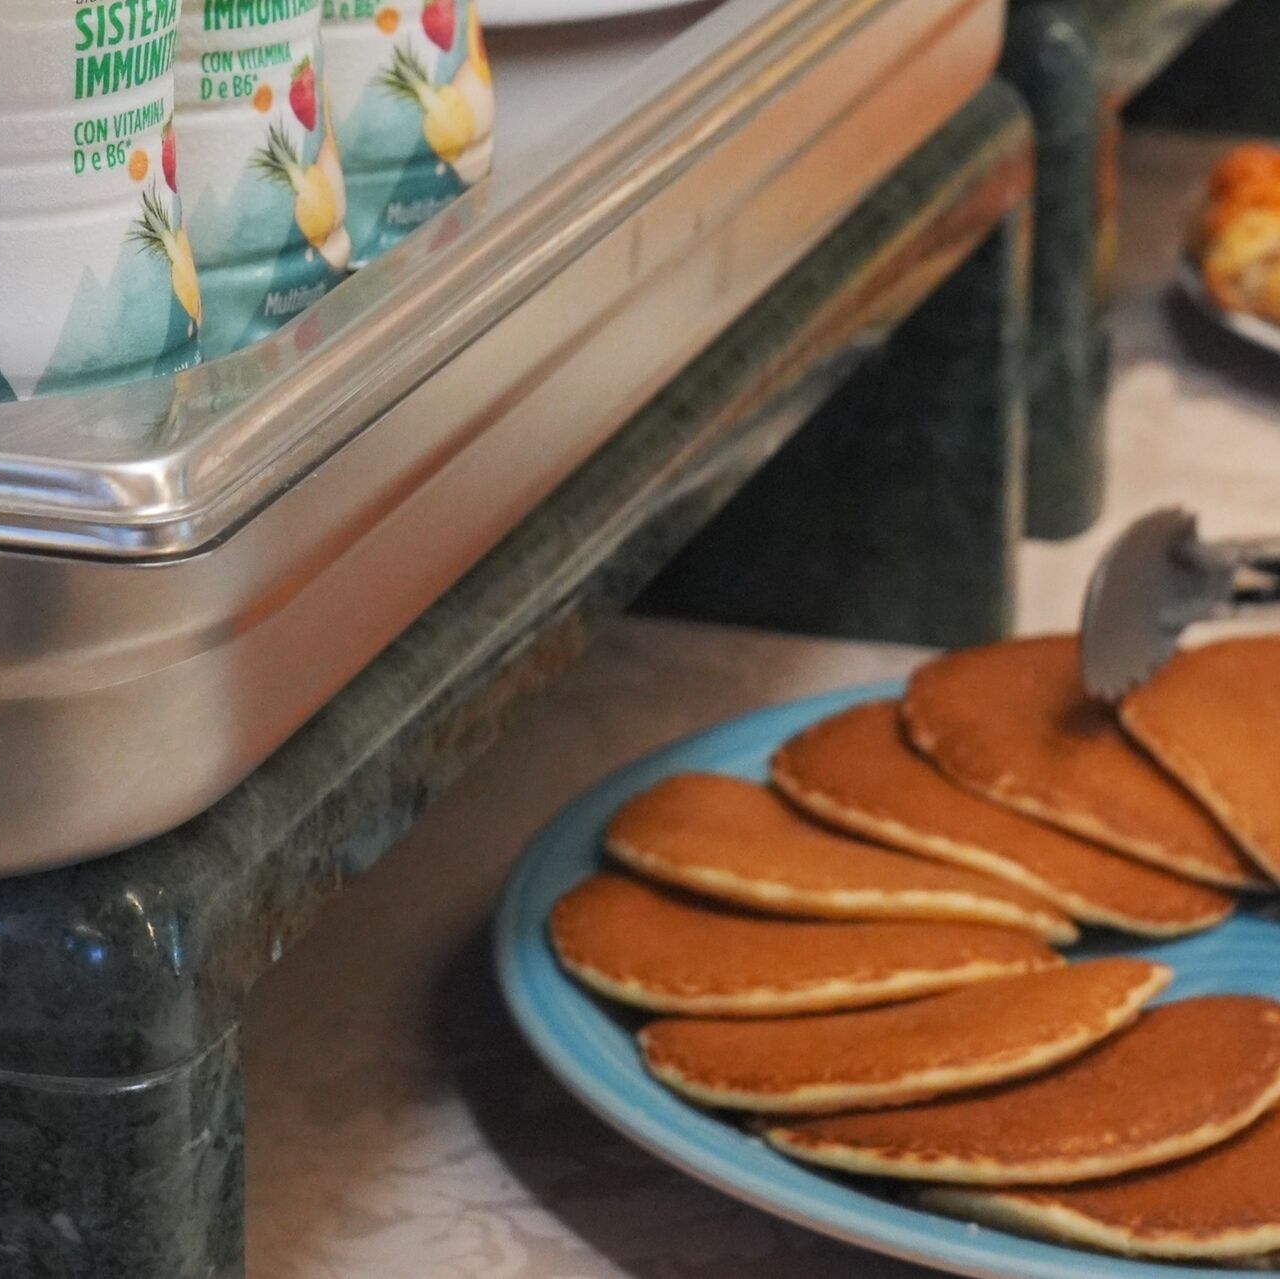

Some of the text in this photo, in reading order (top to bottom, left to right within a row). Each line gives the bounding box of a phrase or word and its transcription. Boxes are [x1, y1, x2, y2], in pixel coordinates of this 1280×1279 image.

[201, 40, 293, 74] CON VITAMINA
[201, 77, 212, 100] D
[218, 79, 228, 98] e
[74, 98, 164, 146] CON VITAMINA
[74, 150, 85, 174] D
[91, 152, 101, 171] e
